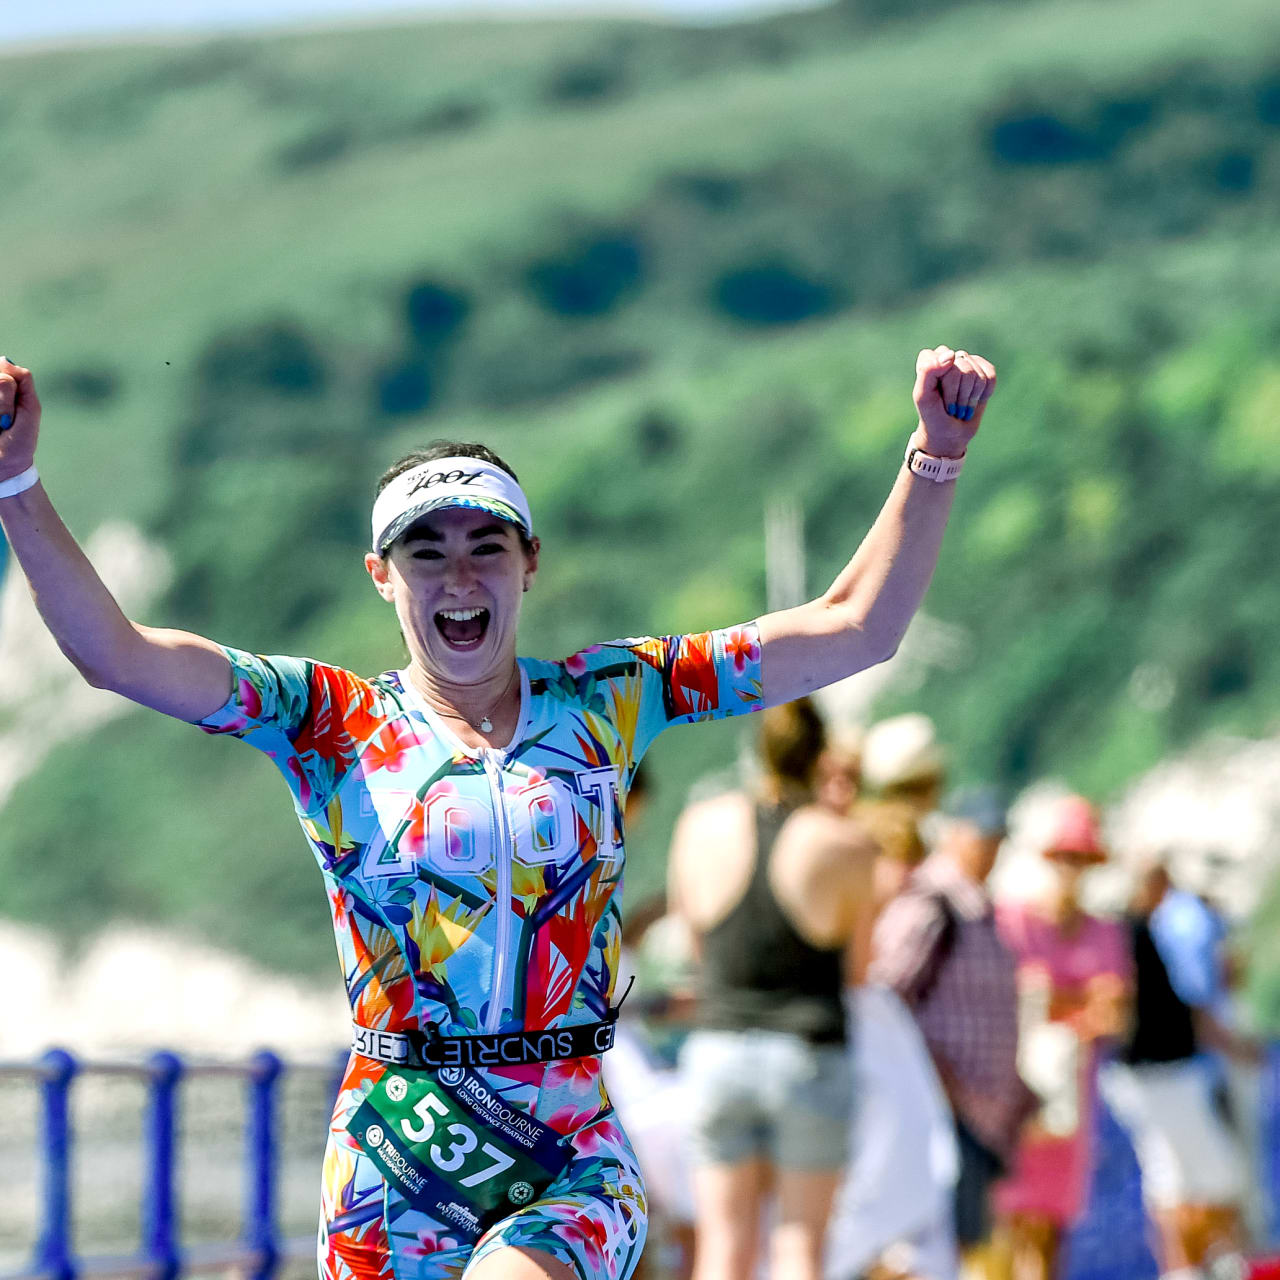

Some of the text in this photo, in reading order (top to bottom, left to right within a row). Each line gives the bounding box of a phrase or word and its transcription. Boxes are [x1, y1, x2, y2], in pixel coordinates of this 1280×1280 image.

[360, 764, 620, 882] ZOOT
[400, 1092, 517, 1188] 537
[456, 1087, 535, 1149] LONG DISTANCE TRIATHLON
[463, 1076, 544, 1141] IRONBOURNE
[382, 1138, 428, 1189] TRIBOURNE
